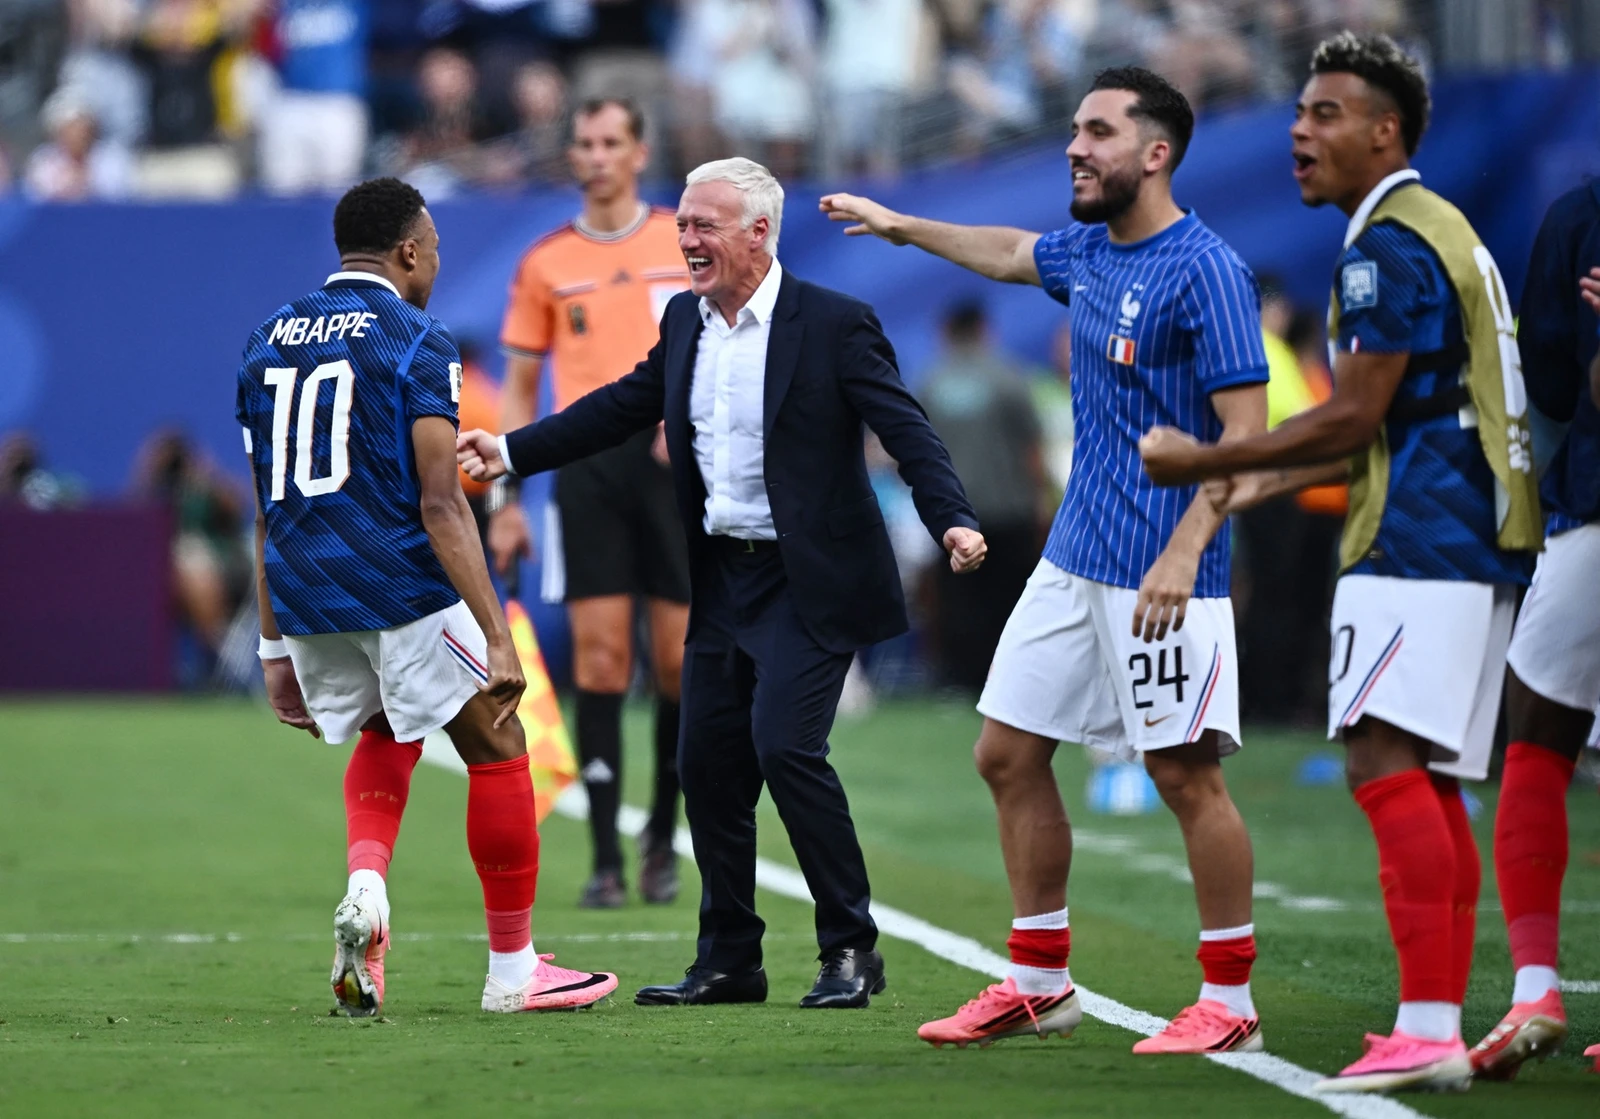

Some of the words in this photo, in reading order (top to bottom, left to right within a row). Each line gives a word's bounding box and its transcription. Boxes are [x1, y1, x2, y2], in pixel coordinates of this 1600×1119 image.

[268, 312, 378, 346] MBAPPE
[264, 359, 355, 502] 10
[1129, 646, 1190, 709] 24
